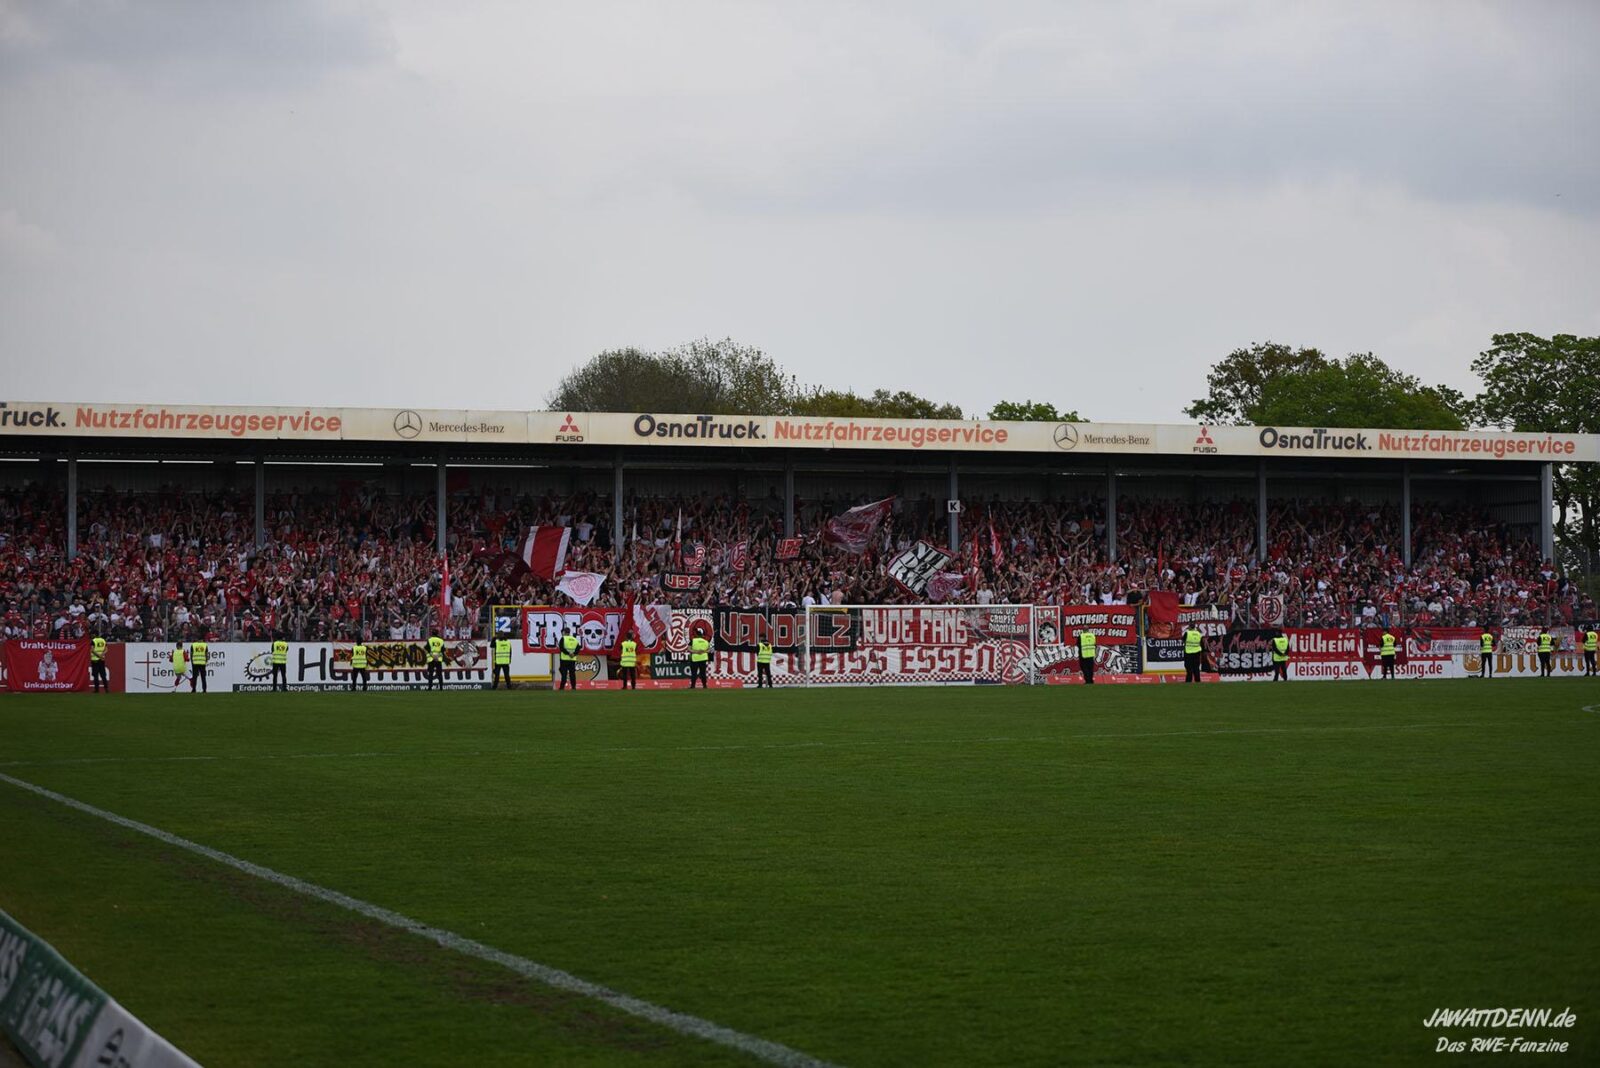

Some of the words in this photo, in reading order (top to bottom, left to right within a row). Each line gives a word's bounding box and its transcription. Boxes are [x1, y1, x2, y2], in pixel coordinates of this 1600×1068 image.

[75, 406, 342, 437] Nutzfahrzeugservice
[428, 421, 505, 434] Mercedes-Benz
[633, 413, 767, 440] OsnaTruck.
[774, 420, 1009, 448] Nutzfahrzeugservice
[555, 434, 584, 443] FUSO
[1083, 433, 1150, 446] Mercedes-Benz
[1259, 426, 1372, 451] OsnaTruck.
[1378, 432, 1576, 458] Nutzfahrzeugservice
[1192, 446, 1218, 454] FUSO
[950, 500, 957, 511] K
[862, 608, 914, 643] RUDE
[919, 608, 968, 643] FANS
[1064, 613, 1109, 625] NORTHSIDE
[1111, 615, 1135, 625] CREW
[720, 612, 851, 648] VANDALZ
[671, 652, 691, 661] ULT
[714, 650, 888, 675] RO-WEISS
[655, 666, 682, 677] WILL
[1295, 661, 1359, 680] leissing.de
[24, 681, 74, 690] Unkaputtbar
[239, 684, 281, 692] Erdarbeitn,
